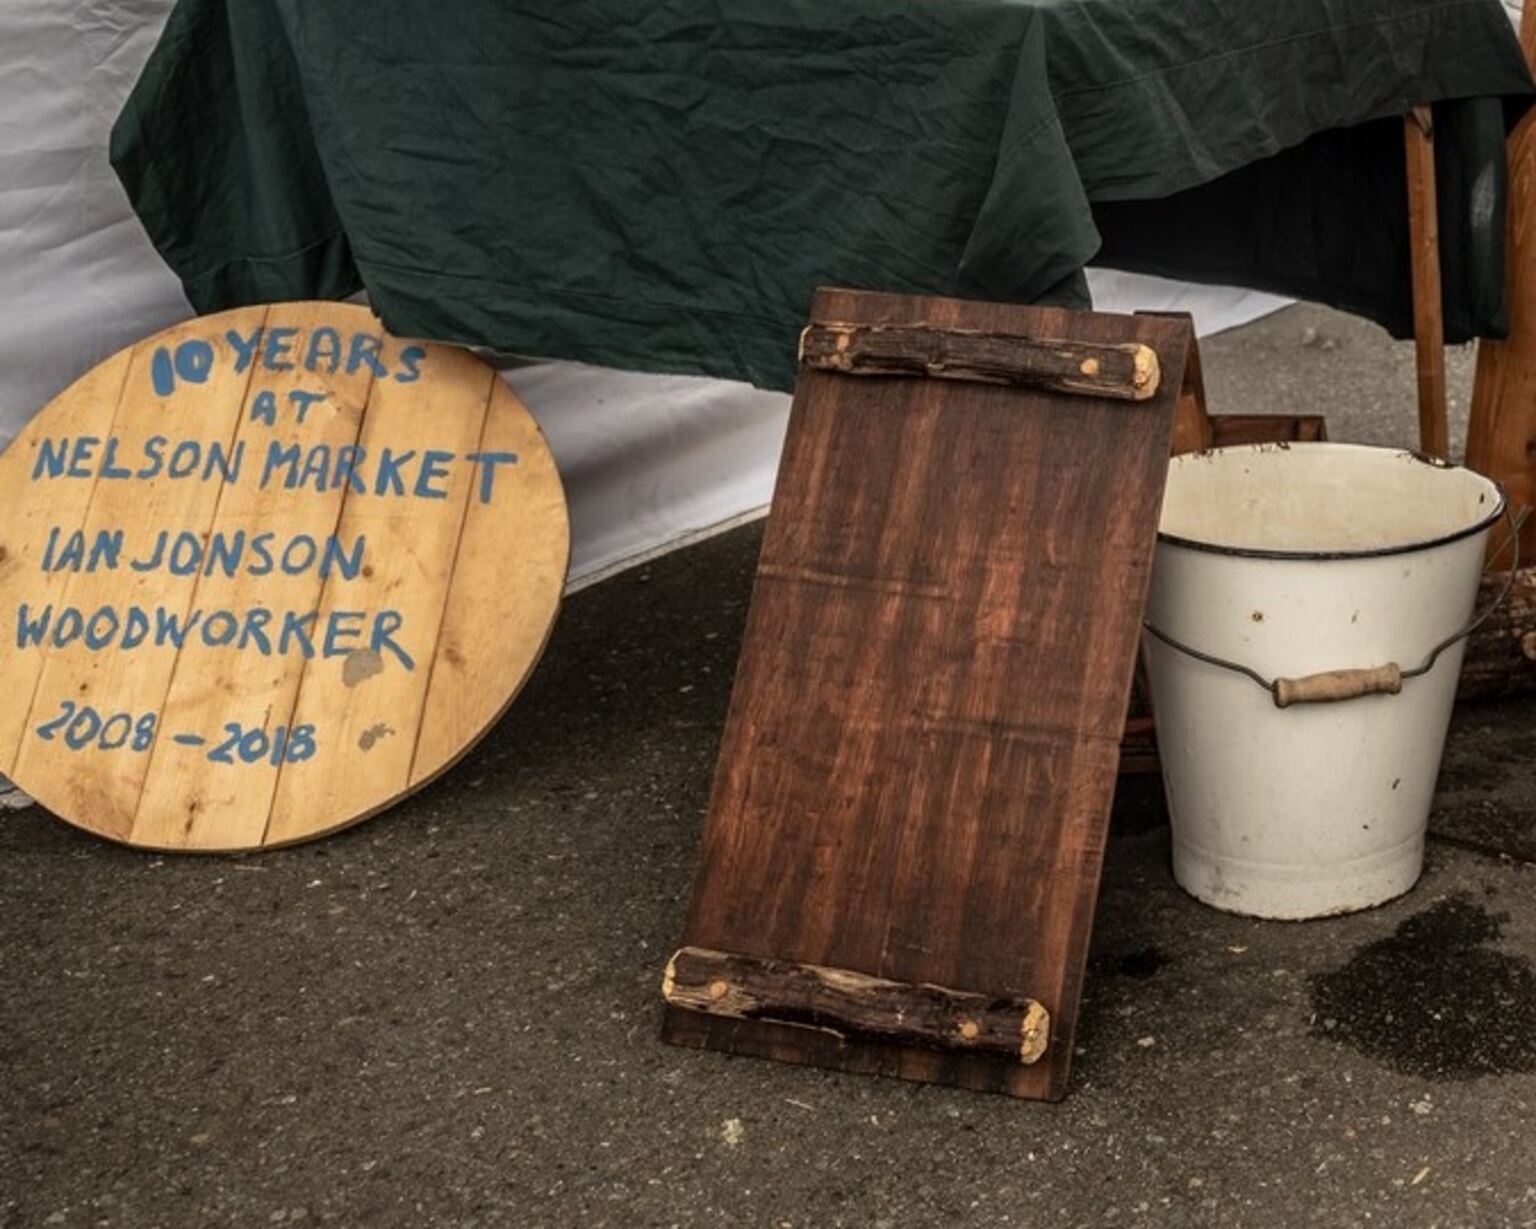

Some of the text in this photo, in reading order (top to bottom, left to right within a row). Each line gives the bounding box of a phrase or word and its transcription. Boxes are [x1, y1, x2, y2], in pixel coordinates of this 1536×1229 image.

[151, 326, 427, 397] 10 YEARS
[249, 389, 327, 427] AT
[31, 436, 518, 505] NELSON MARKET
[40, 526, 366, 581] IAN JONSON
[15, 604, 415, 671] WOODWORKER
